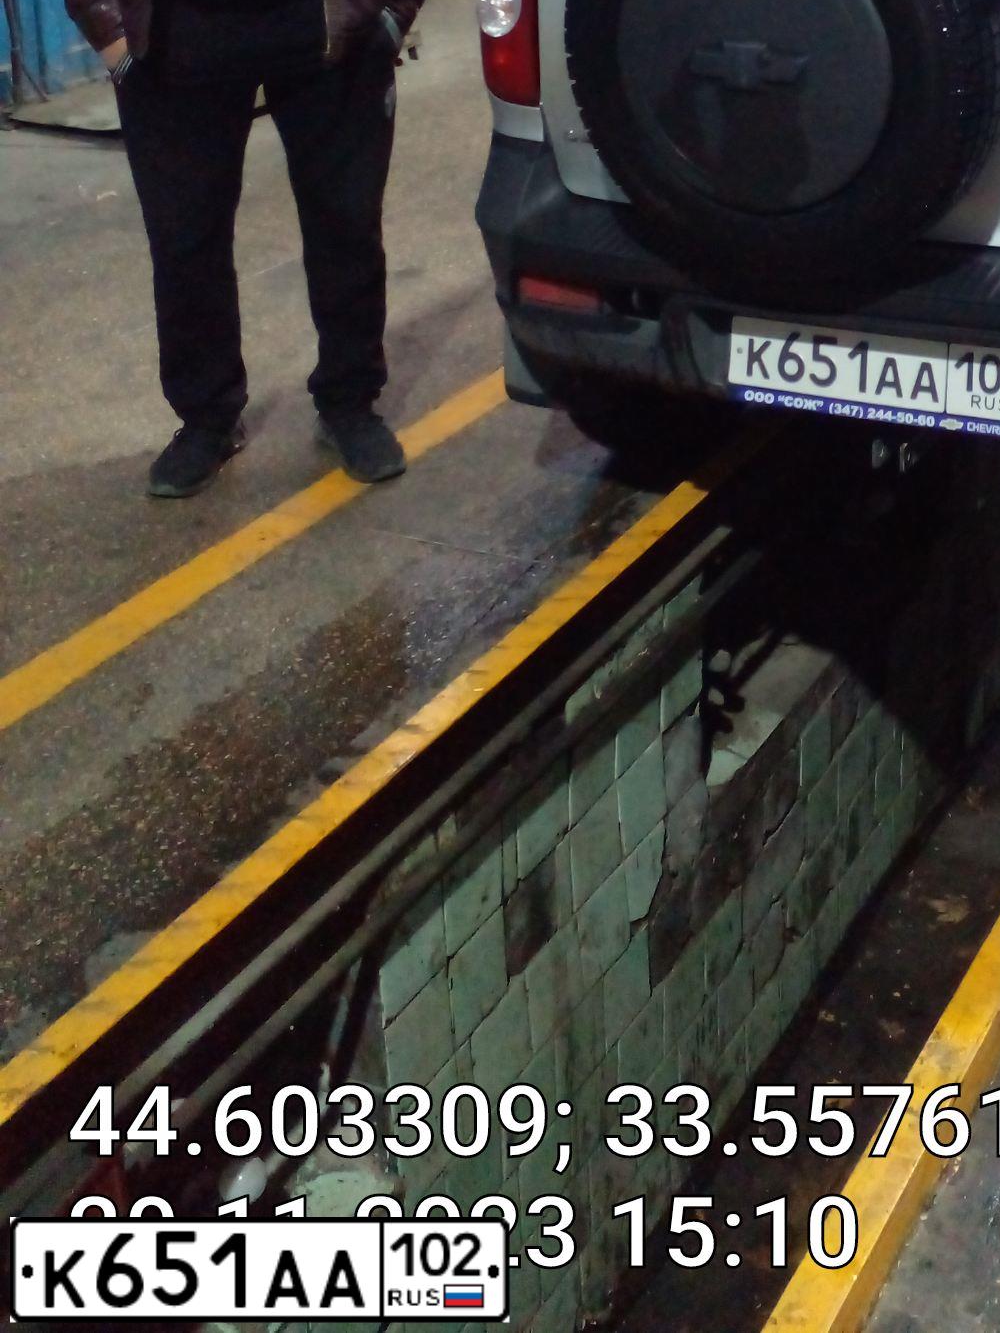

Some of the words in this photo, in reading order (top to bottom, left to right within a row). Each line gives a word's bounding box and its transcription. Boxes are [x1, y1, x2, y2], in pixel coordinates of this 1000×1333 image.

[747, 331, 940, 403] К651АА
[744, 390, 775, 404] ООО
[828, 403, 864, 419] (347)
